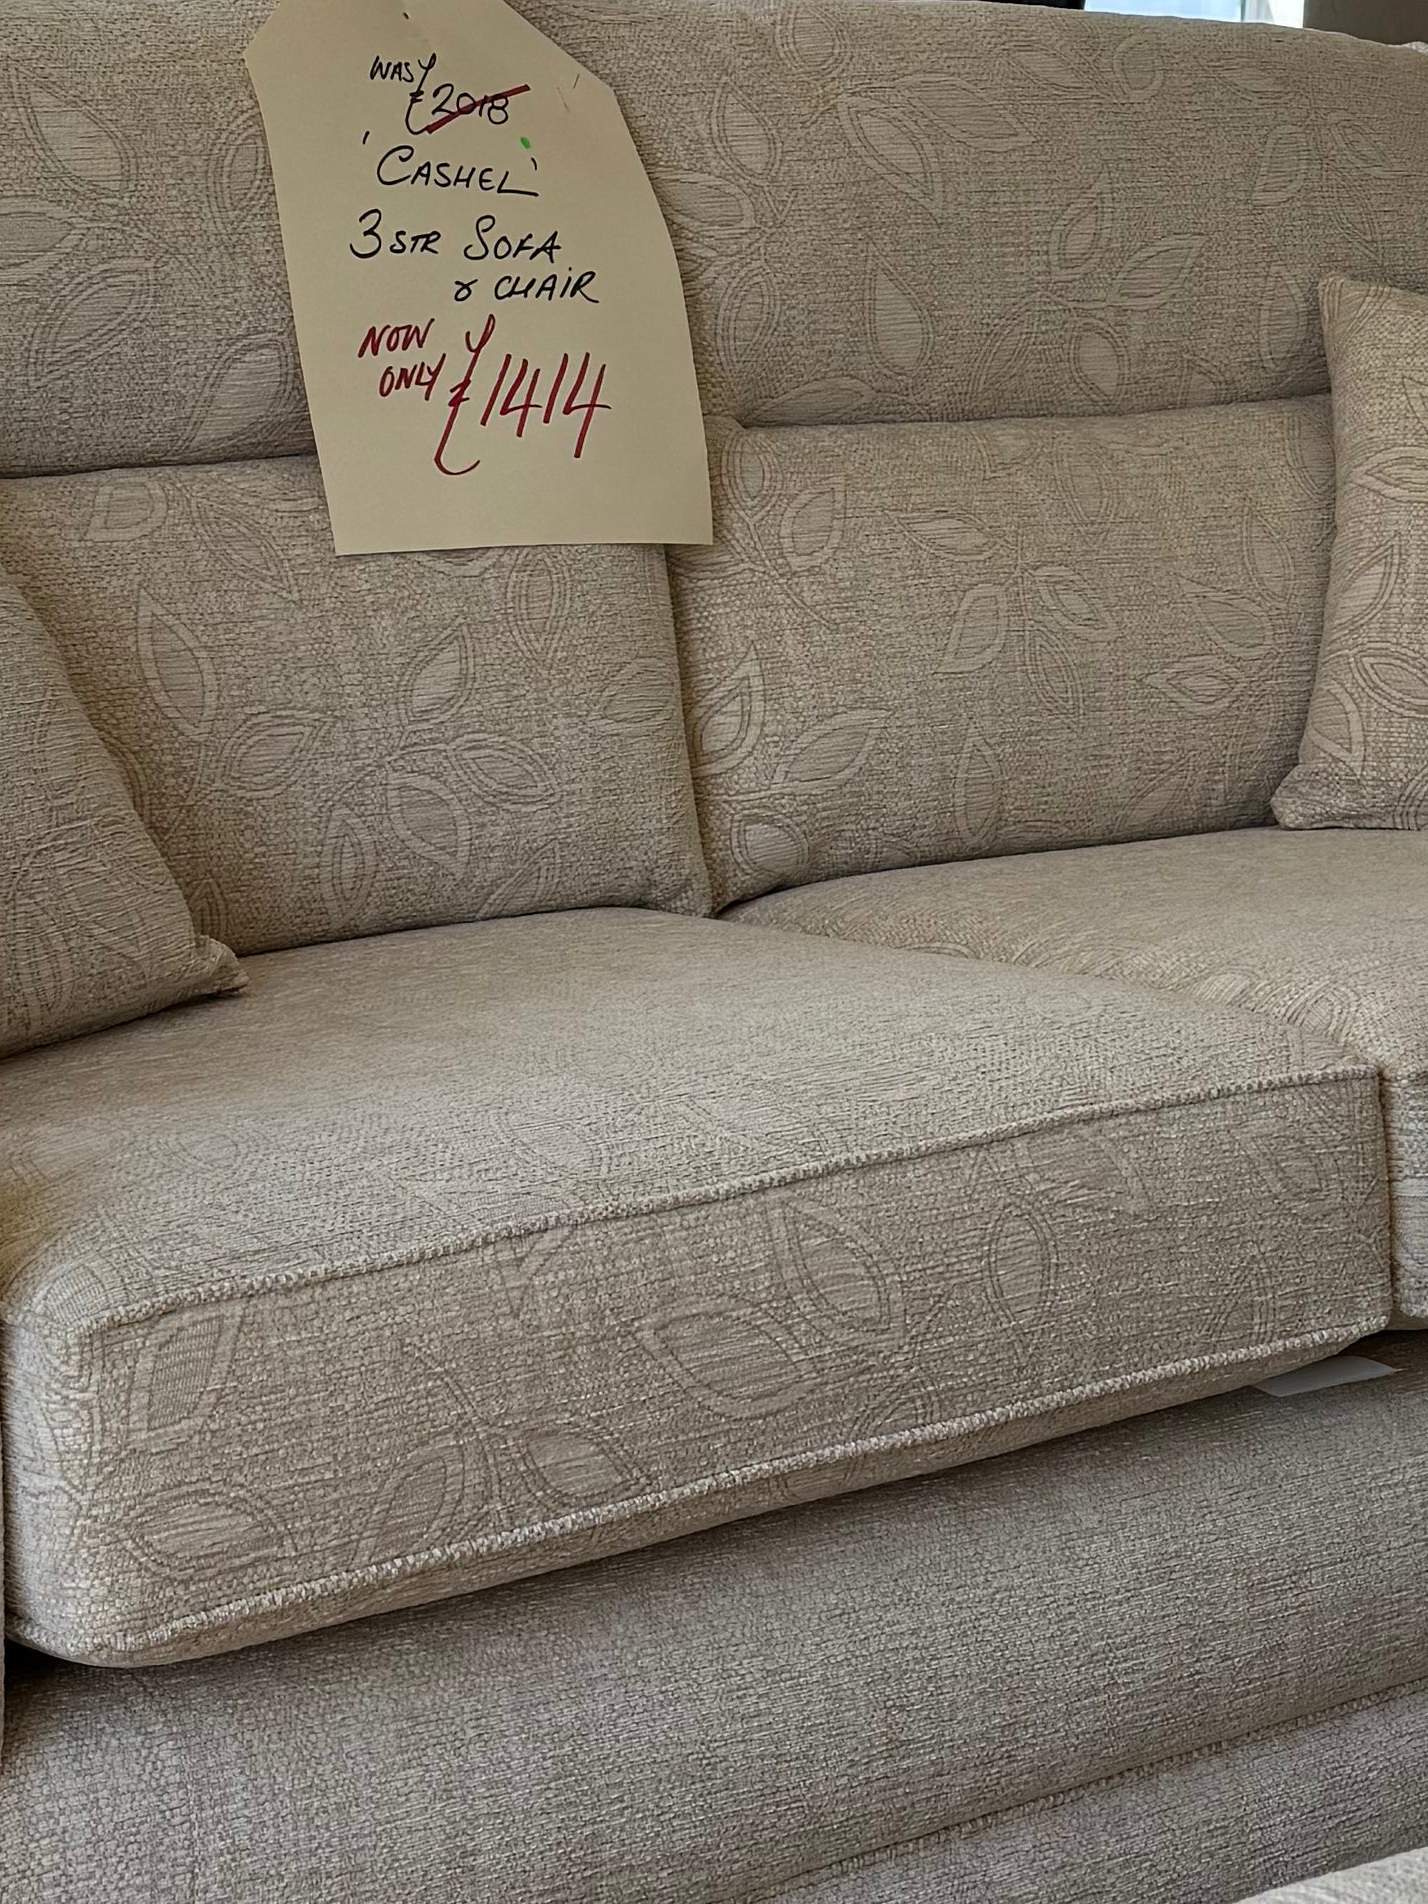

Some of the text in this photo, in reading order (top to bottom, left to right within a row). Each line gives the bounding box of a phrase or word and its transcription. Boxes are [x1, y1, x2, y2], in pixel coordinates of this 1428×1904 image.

[370, 55, 414, 83] WAS
[462, 213, 562, 263] SOFA
[494, 266, 599, 303] CHAIR
[358, 319, 435, 357] NOW
[379, 353, 446, 400] ONLY
[434, 313, 612, 476] £1414
